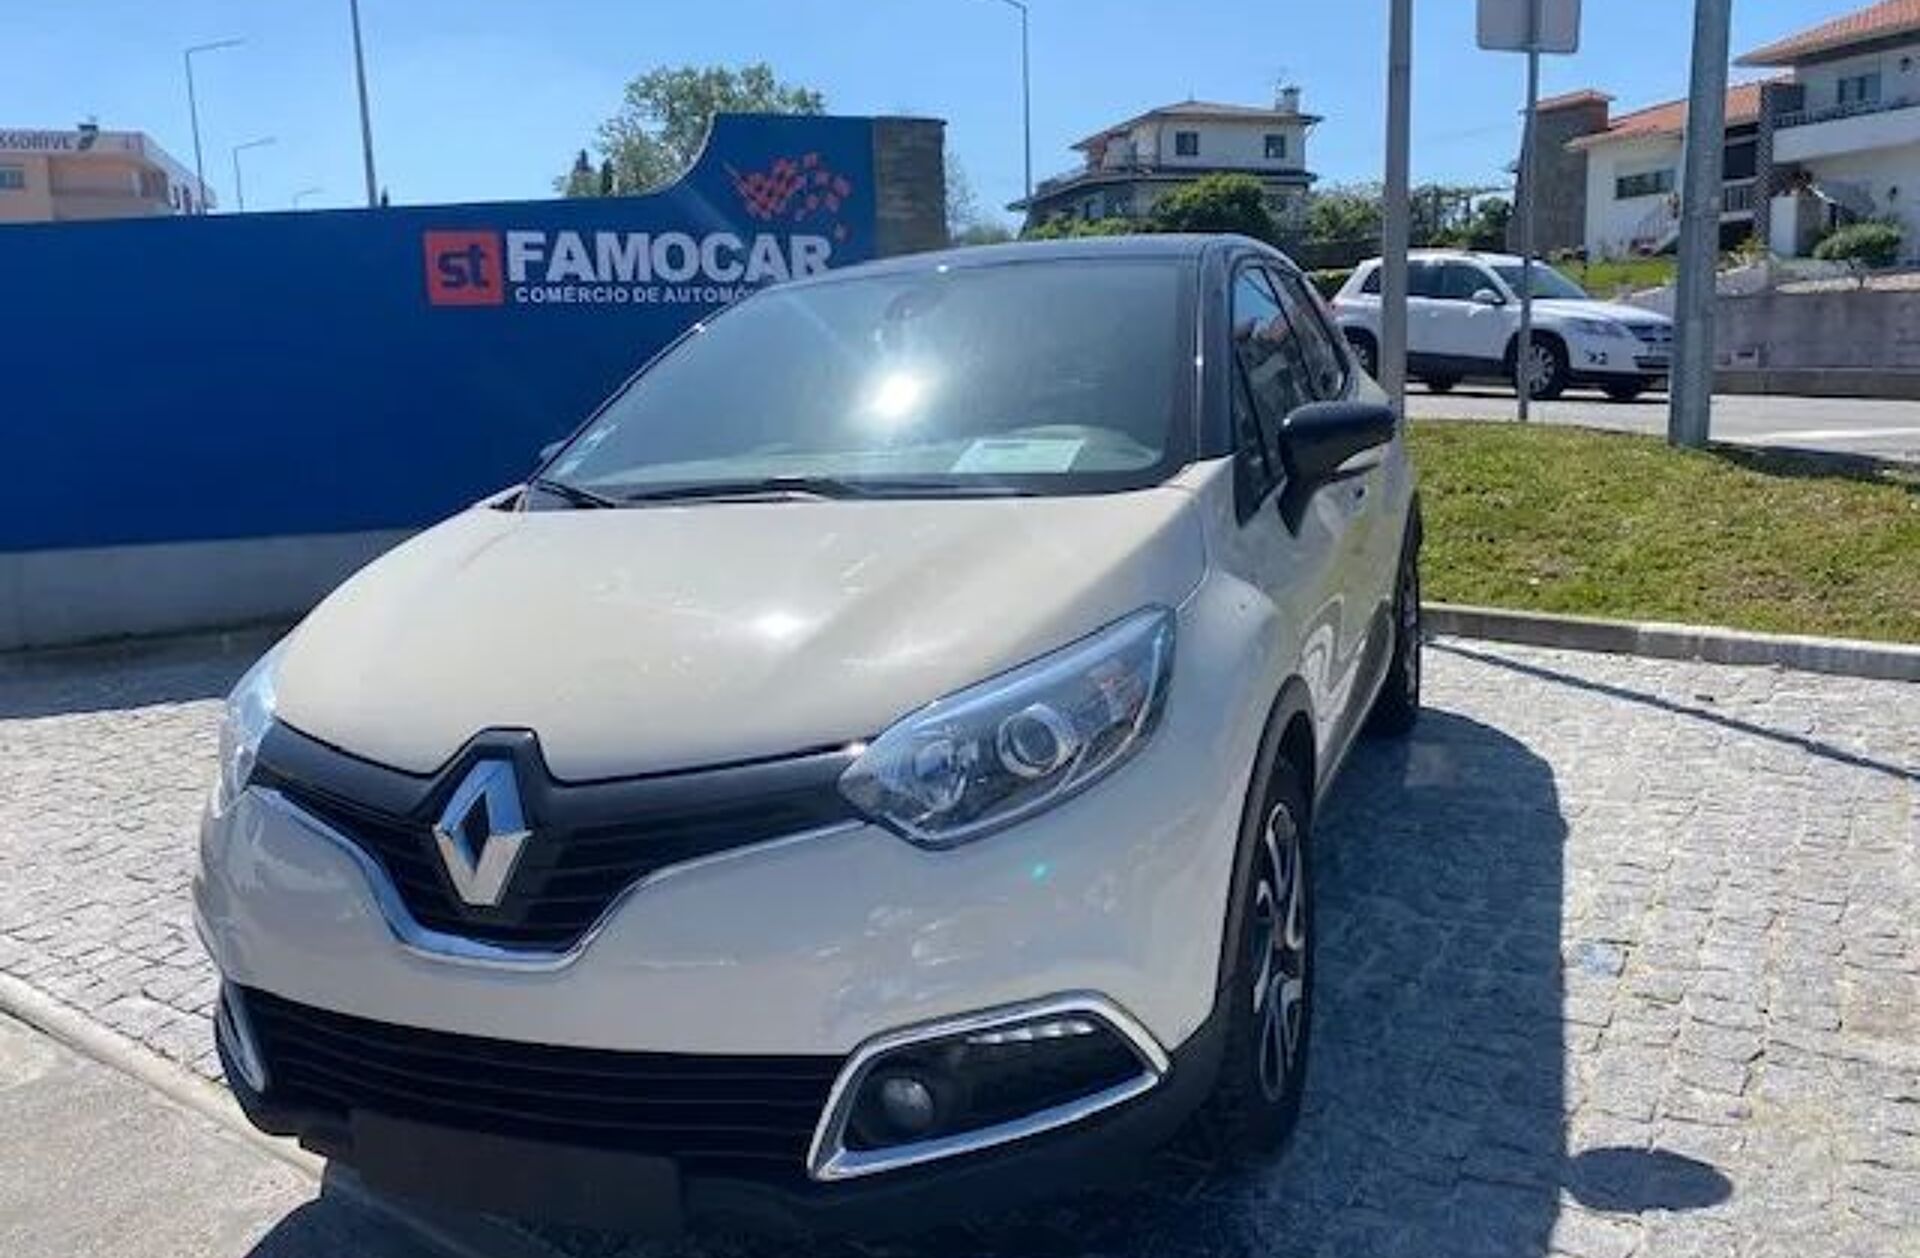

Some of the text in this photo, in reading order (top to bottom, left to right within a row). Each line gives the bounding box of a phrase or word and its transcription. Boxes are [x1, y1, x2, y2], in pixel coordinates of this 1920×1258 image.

[437, 244, 491, 289] st
[506, 230, 832, 283] FAMOCAR
[632, 286, 660, 303] DE
